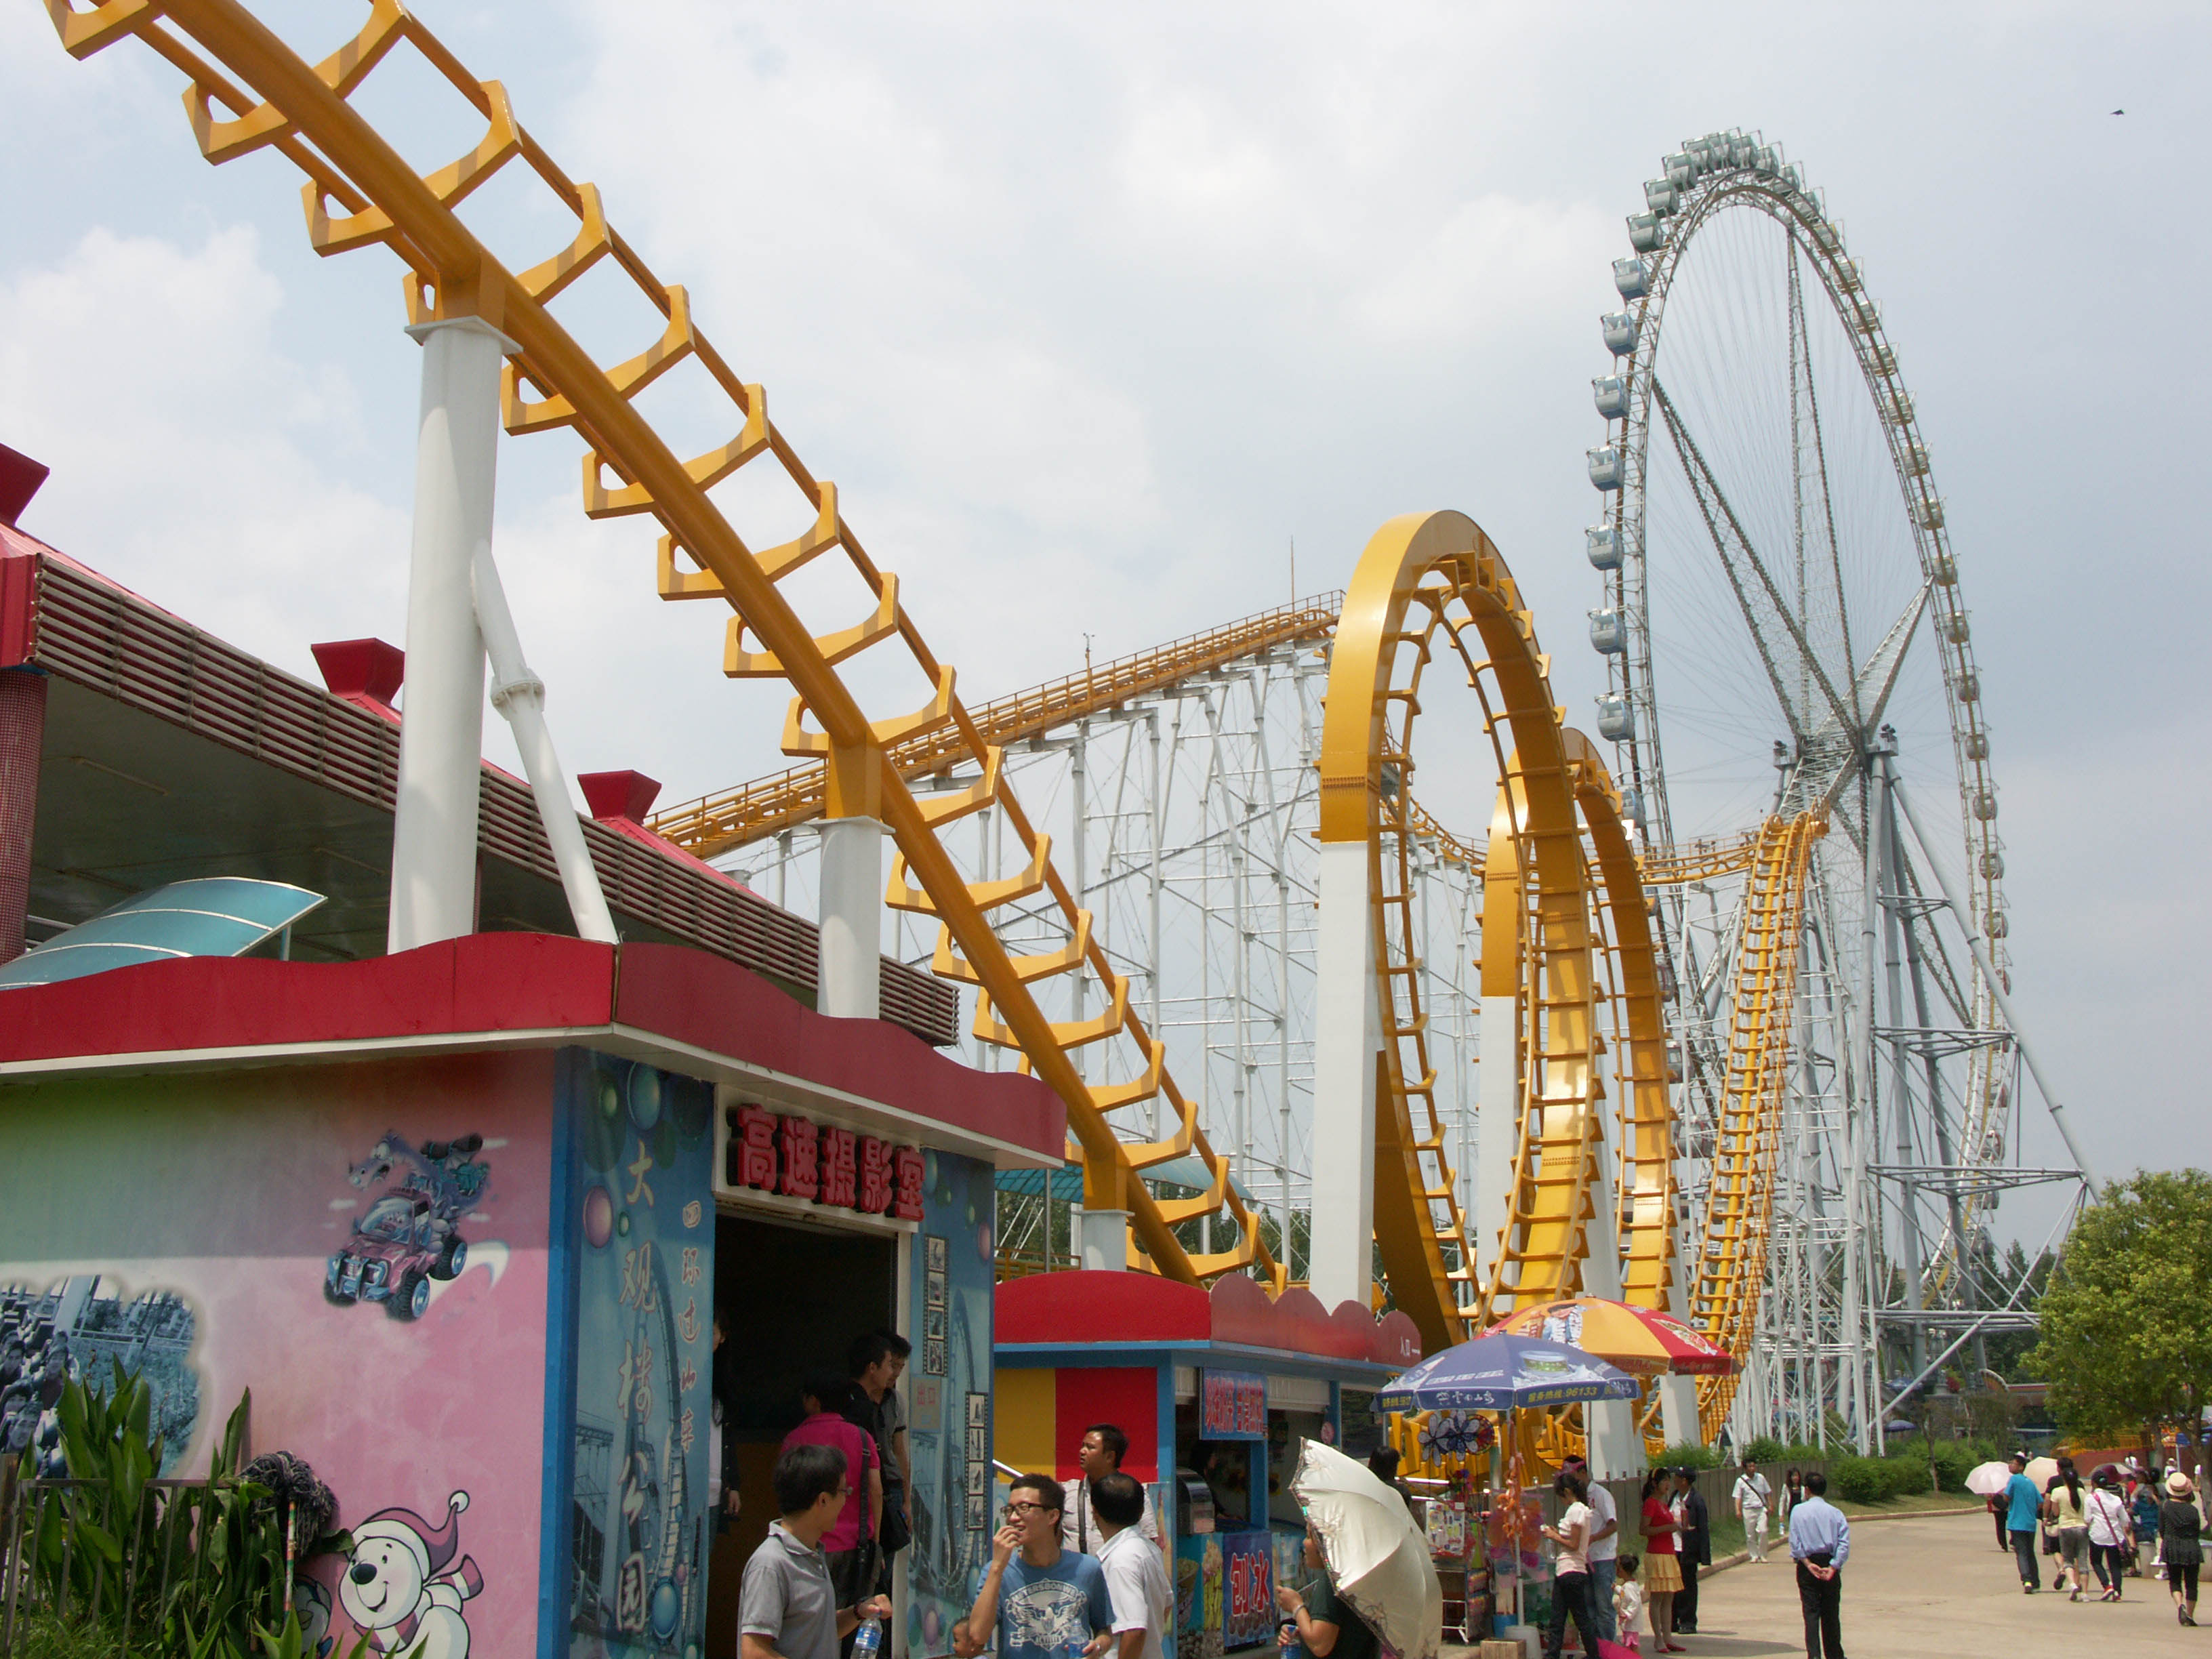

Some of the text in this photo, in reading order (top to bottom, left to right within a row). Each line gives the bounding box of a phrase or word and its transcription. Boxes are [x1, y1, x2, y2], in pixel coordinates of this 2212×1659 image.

[737, 1103, 926, 1223] 高速摄影室
[617, 1139, 657, 1632] 大观楼公园
[1230, 1549, 1271, 1617] 刨冰
